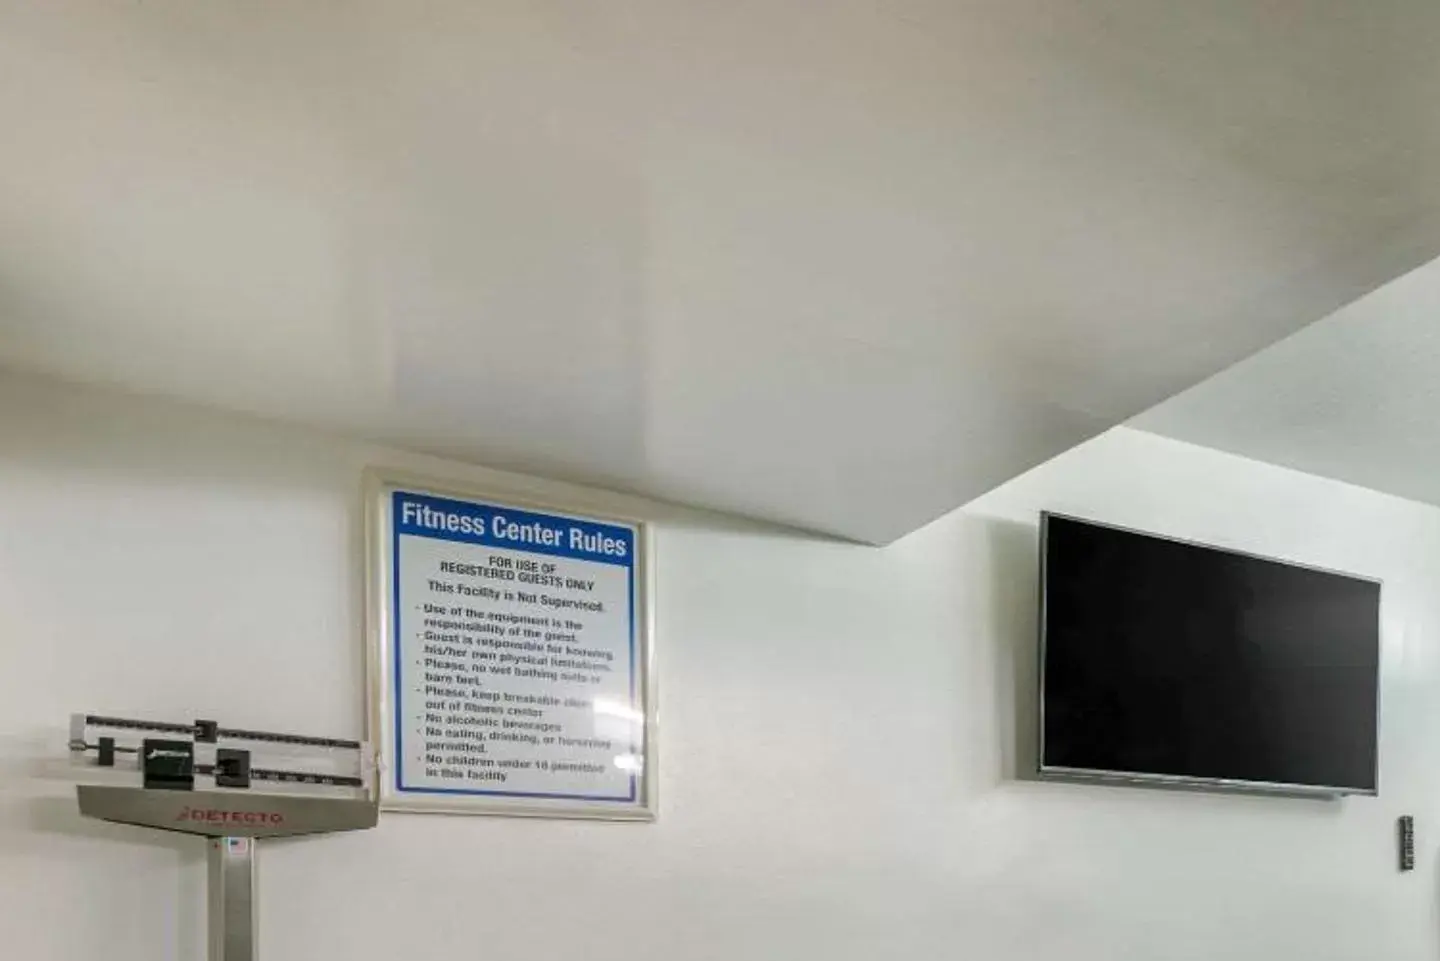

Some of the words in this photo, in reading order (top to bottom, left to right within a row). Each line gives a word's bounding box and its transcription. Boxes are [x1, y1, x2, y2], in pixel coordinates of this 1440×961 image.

[402, 502, 485, 535] Fitness
[492, 516, 563, 546] Center
[570, 528, 627, 556] Rules
[489, 556, 512, 568] FOR
[516, 560, 537, 572] USE
[541, 564, 556, 573] OF
[440, 562, 515, 581] REGISTERED
[518, 571, 563, 588] GUESTS
[566, 579, 594, 591] ONLY
[428, 581, 453, 594] This
[457, 584, 499, 600] Facility
[504, 590, 514, 599] is
[518, 592, 537, 603] Not
[424, 604, 446, 614] Use
[450, 606, 462, 616] of
[466, 608, 484, 619] the
[552, 618, 561, 628] is
[565, 620, 582, 630] the
[425, 632, 459, 643] Guest
[509, 627, 520, 636] of
[523, 628, 540, 638] the
[424, 645, 467, 657] his/her
[472, 664, 486, 673] no
[489, 664, 511, 675] wet
[425, 701, 446, 710] out
[425, 727, 442, 737] No
[425, 754, 442, 764] No
[191, 810, 284, 823] DETECTO
